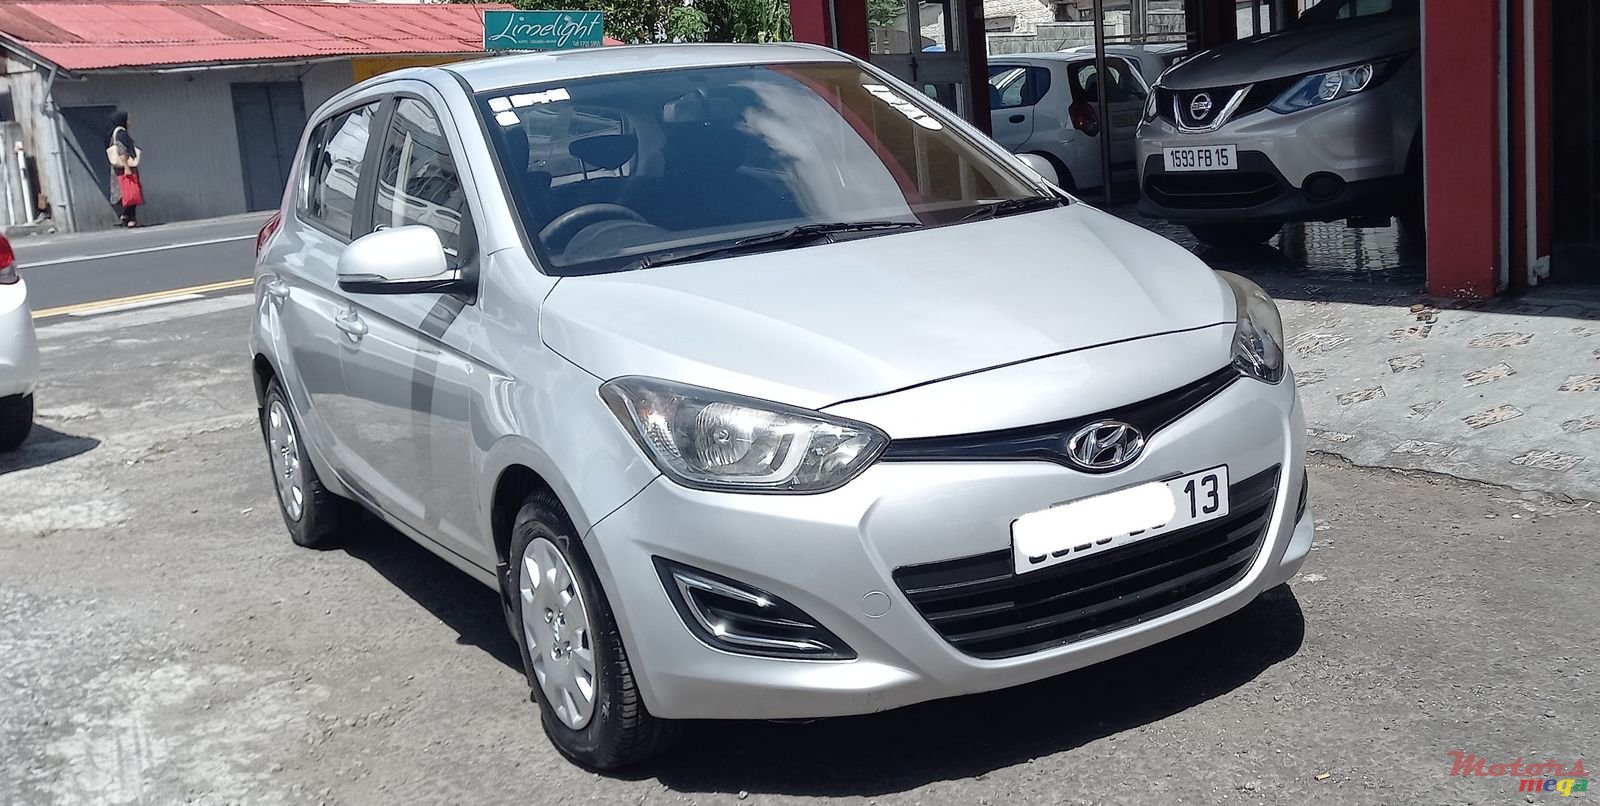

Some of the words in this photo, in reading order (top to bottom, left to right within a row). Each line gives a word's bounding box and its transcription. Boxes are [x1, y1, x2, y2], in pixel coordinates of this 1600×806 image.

[488, 13, 601, 47] Limelight
[1170, 150, 1195, 168] 1593
[1197, 149, 1212, 167] FB
[1215, 148, 1229, 166] 15
[1183, 474, 1219, 518] 13
